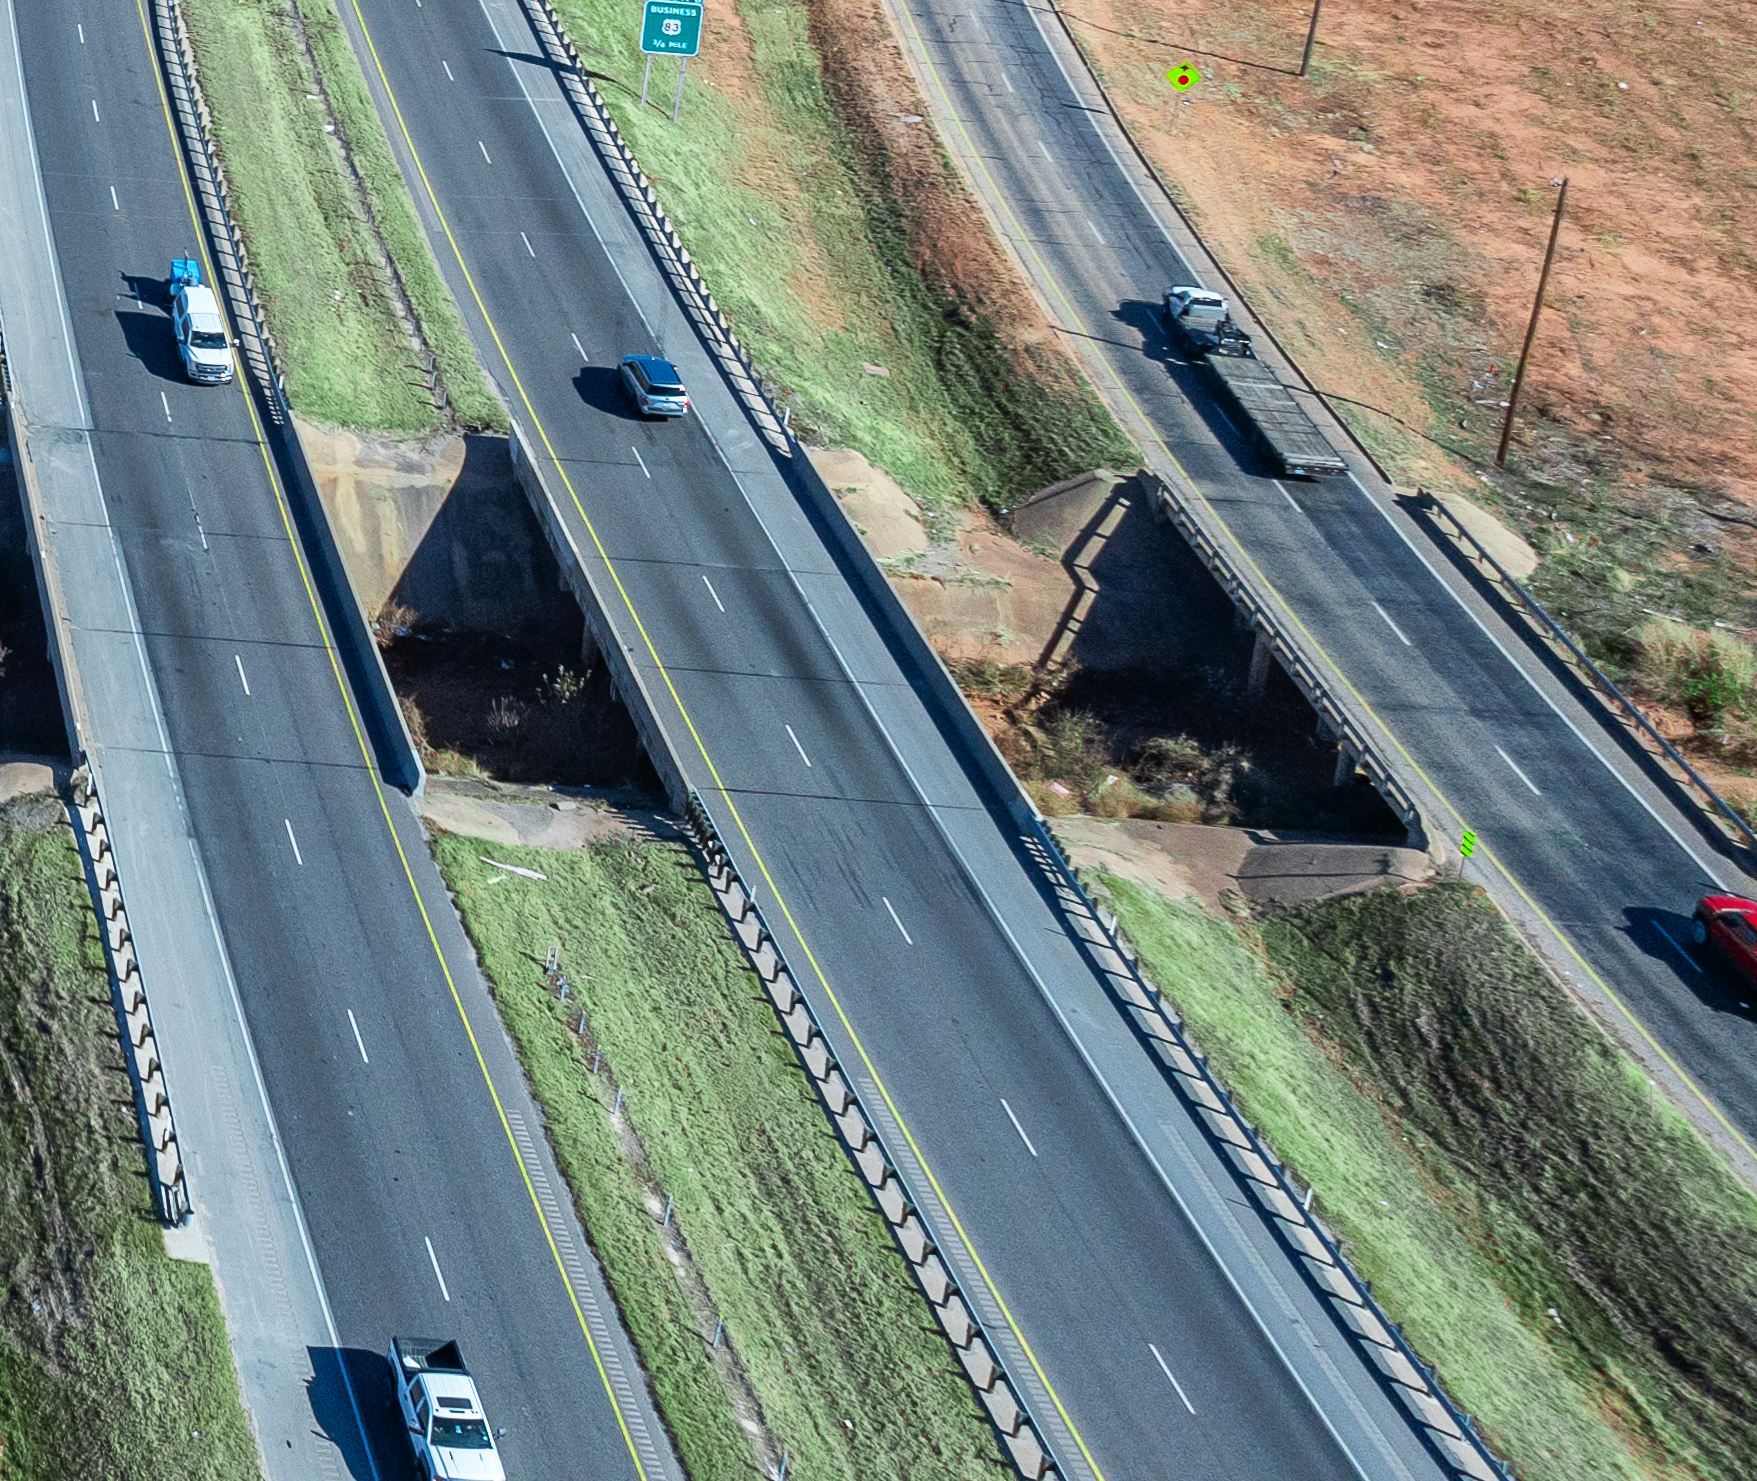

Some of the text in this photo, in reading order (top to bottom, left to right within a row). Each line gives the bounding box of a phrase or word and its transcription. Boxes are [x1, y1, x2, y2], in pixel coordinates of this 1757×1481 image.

[650, 5, 697, 17] BUSINESS
[664, 22, 679, 32] 83
[668, 40, 688, 50] MILE
